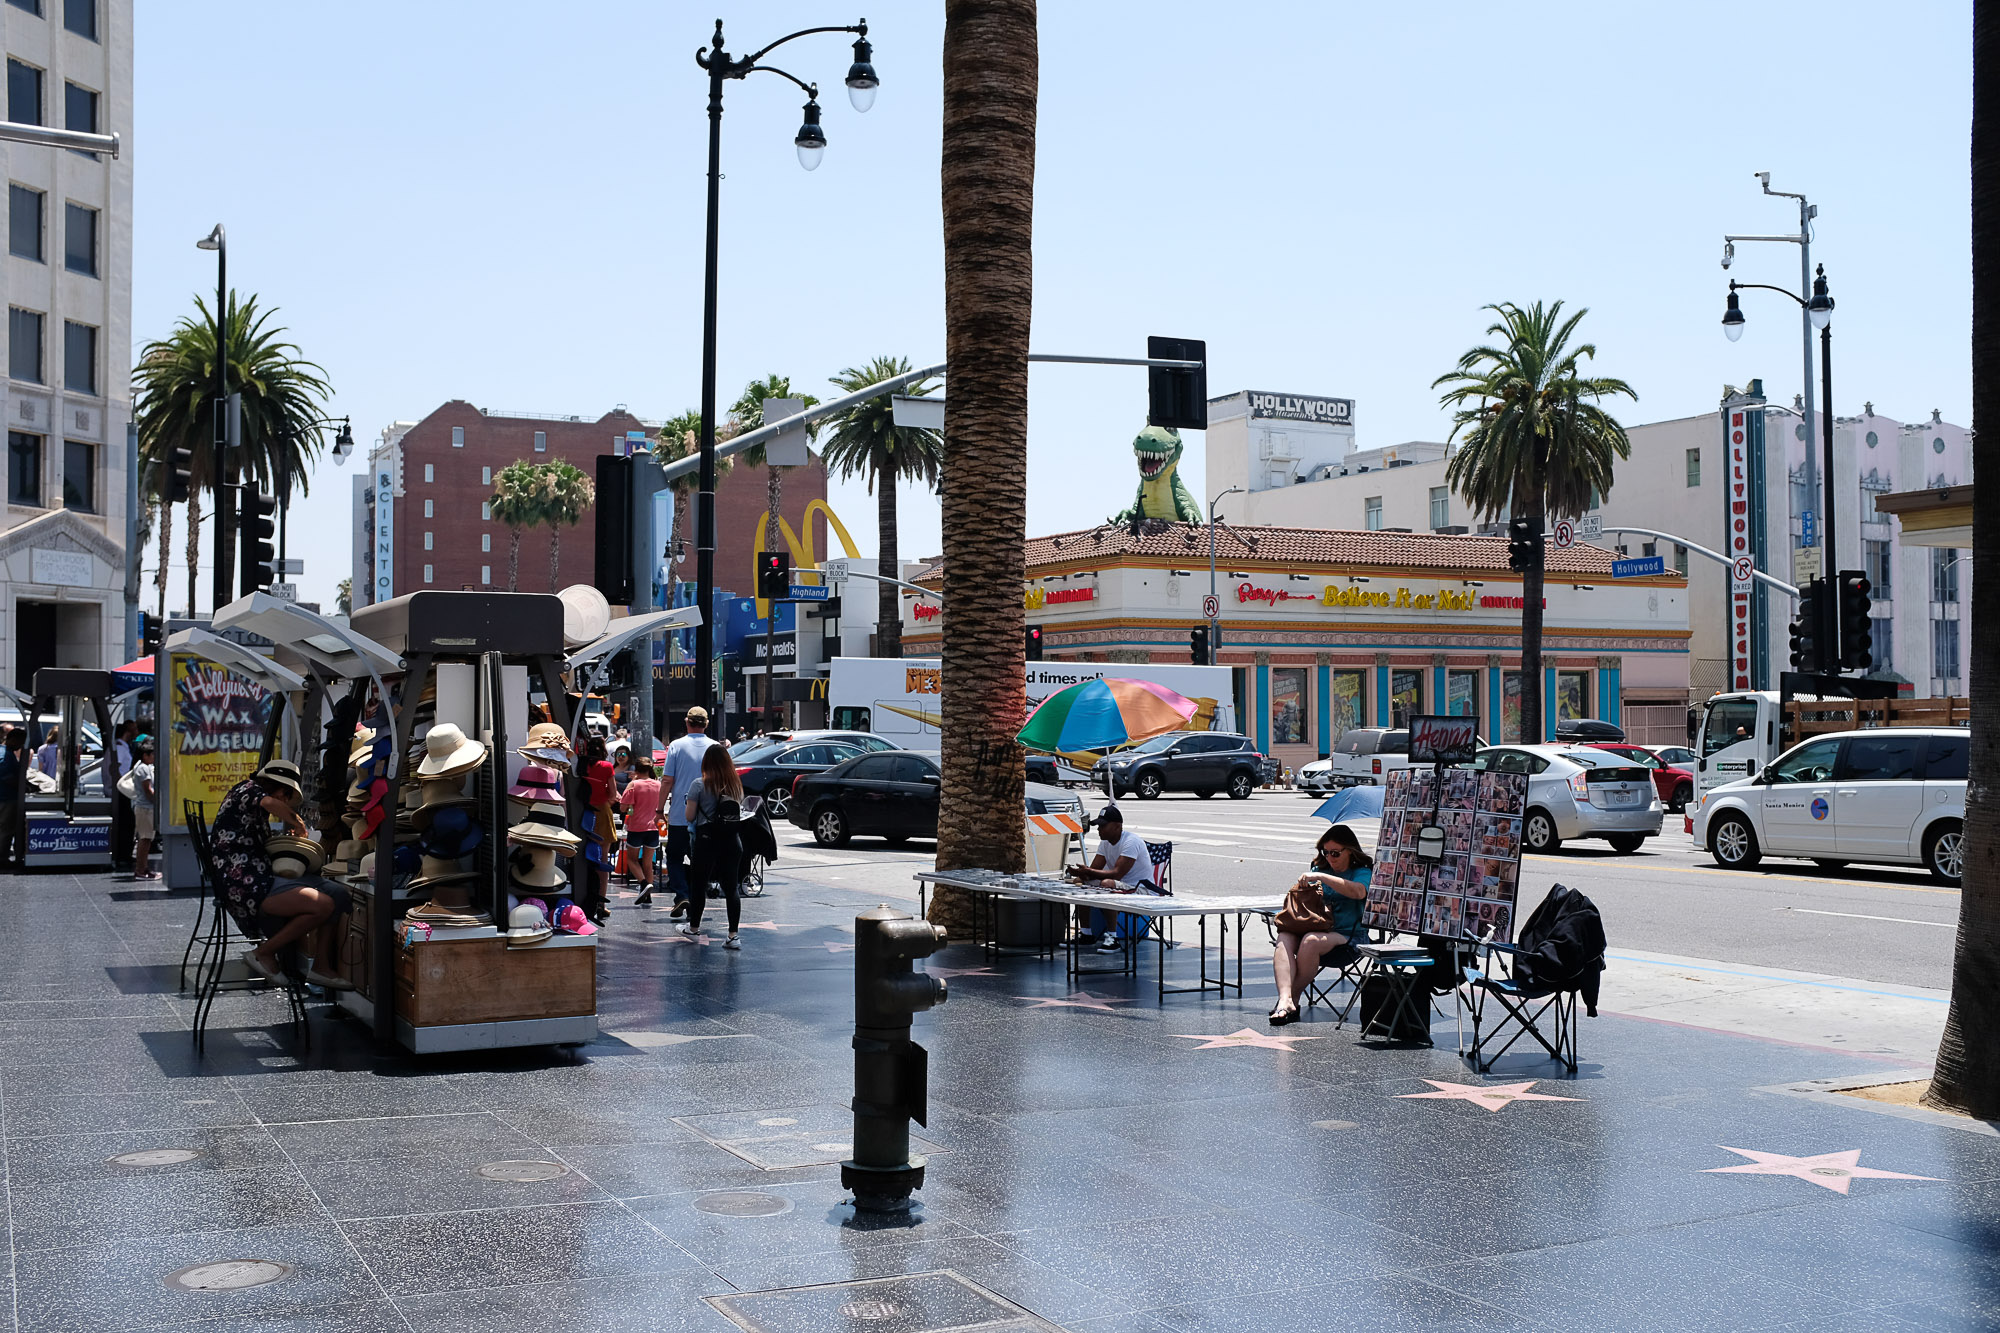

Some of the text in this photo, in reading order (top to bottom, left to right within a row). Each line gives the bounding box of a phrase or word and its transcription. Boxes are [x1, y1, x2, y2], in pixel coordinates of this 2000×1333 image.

[1252, 394, 1348, 417] HOLLYWOOD
[1590, 517, 1599, 525] NOT
[1617, 561, 1659, 575] Hollywood
[791, 587, 826, 598] Highland
[1321, 584, 1391, 608] Believe
[1394, 587, 1412, 609] It
[1414, 593, 1435, 610] or
[1437, 588, 1477, 611] Not!
[1039, 671, 1077, 684] times
[1412, 719, 1472, 754] Henna
[194, 763, 223, 772] MOST
[1718, 763, 1746, 771] enterprise
[208, 785, 231, 793] SINCE
[29, 825, 109, 836] BUY TICKETS HERE!
[80, 839, 109, 848] TOURS
